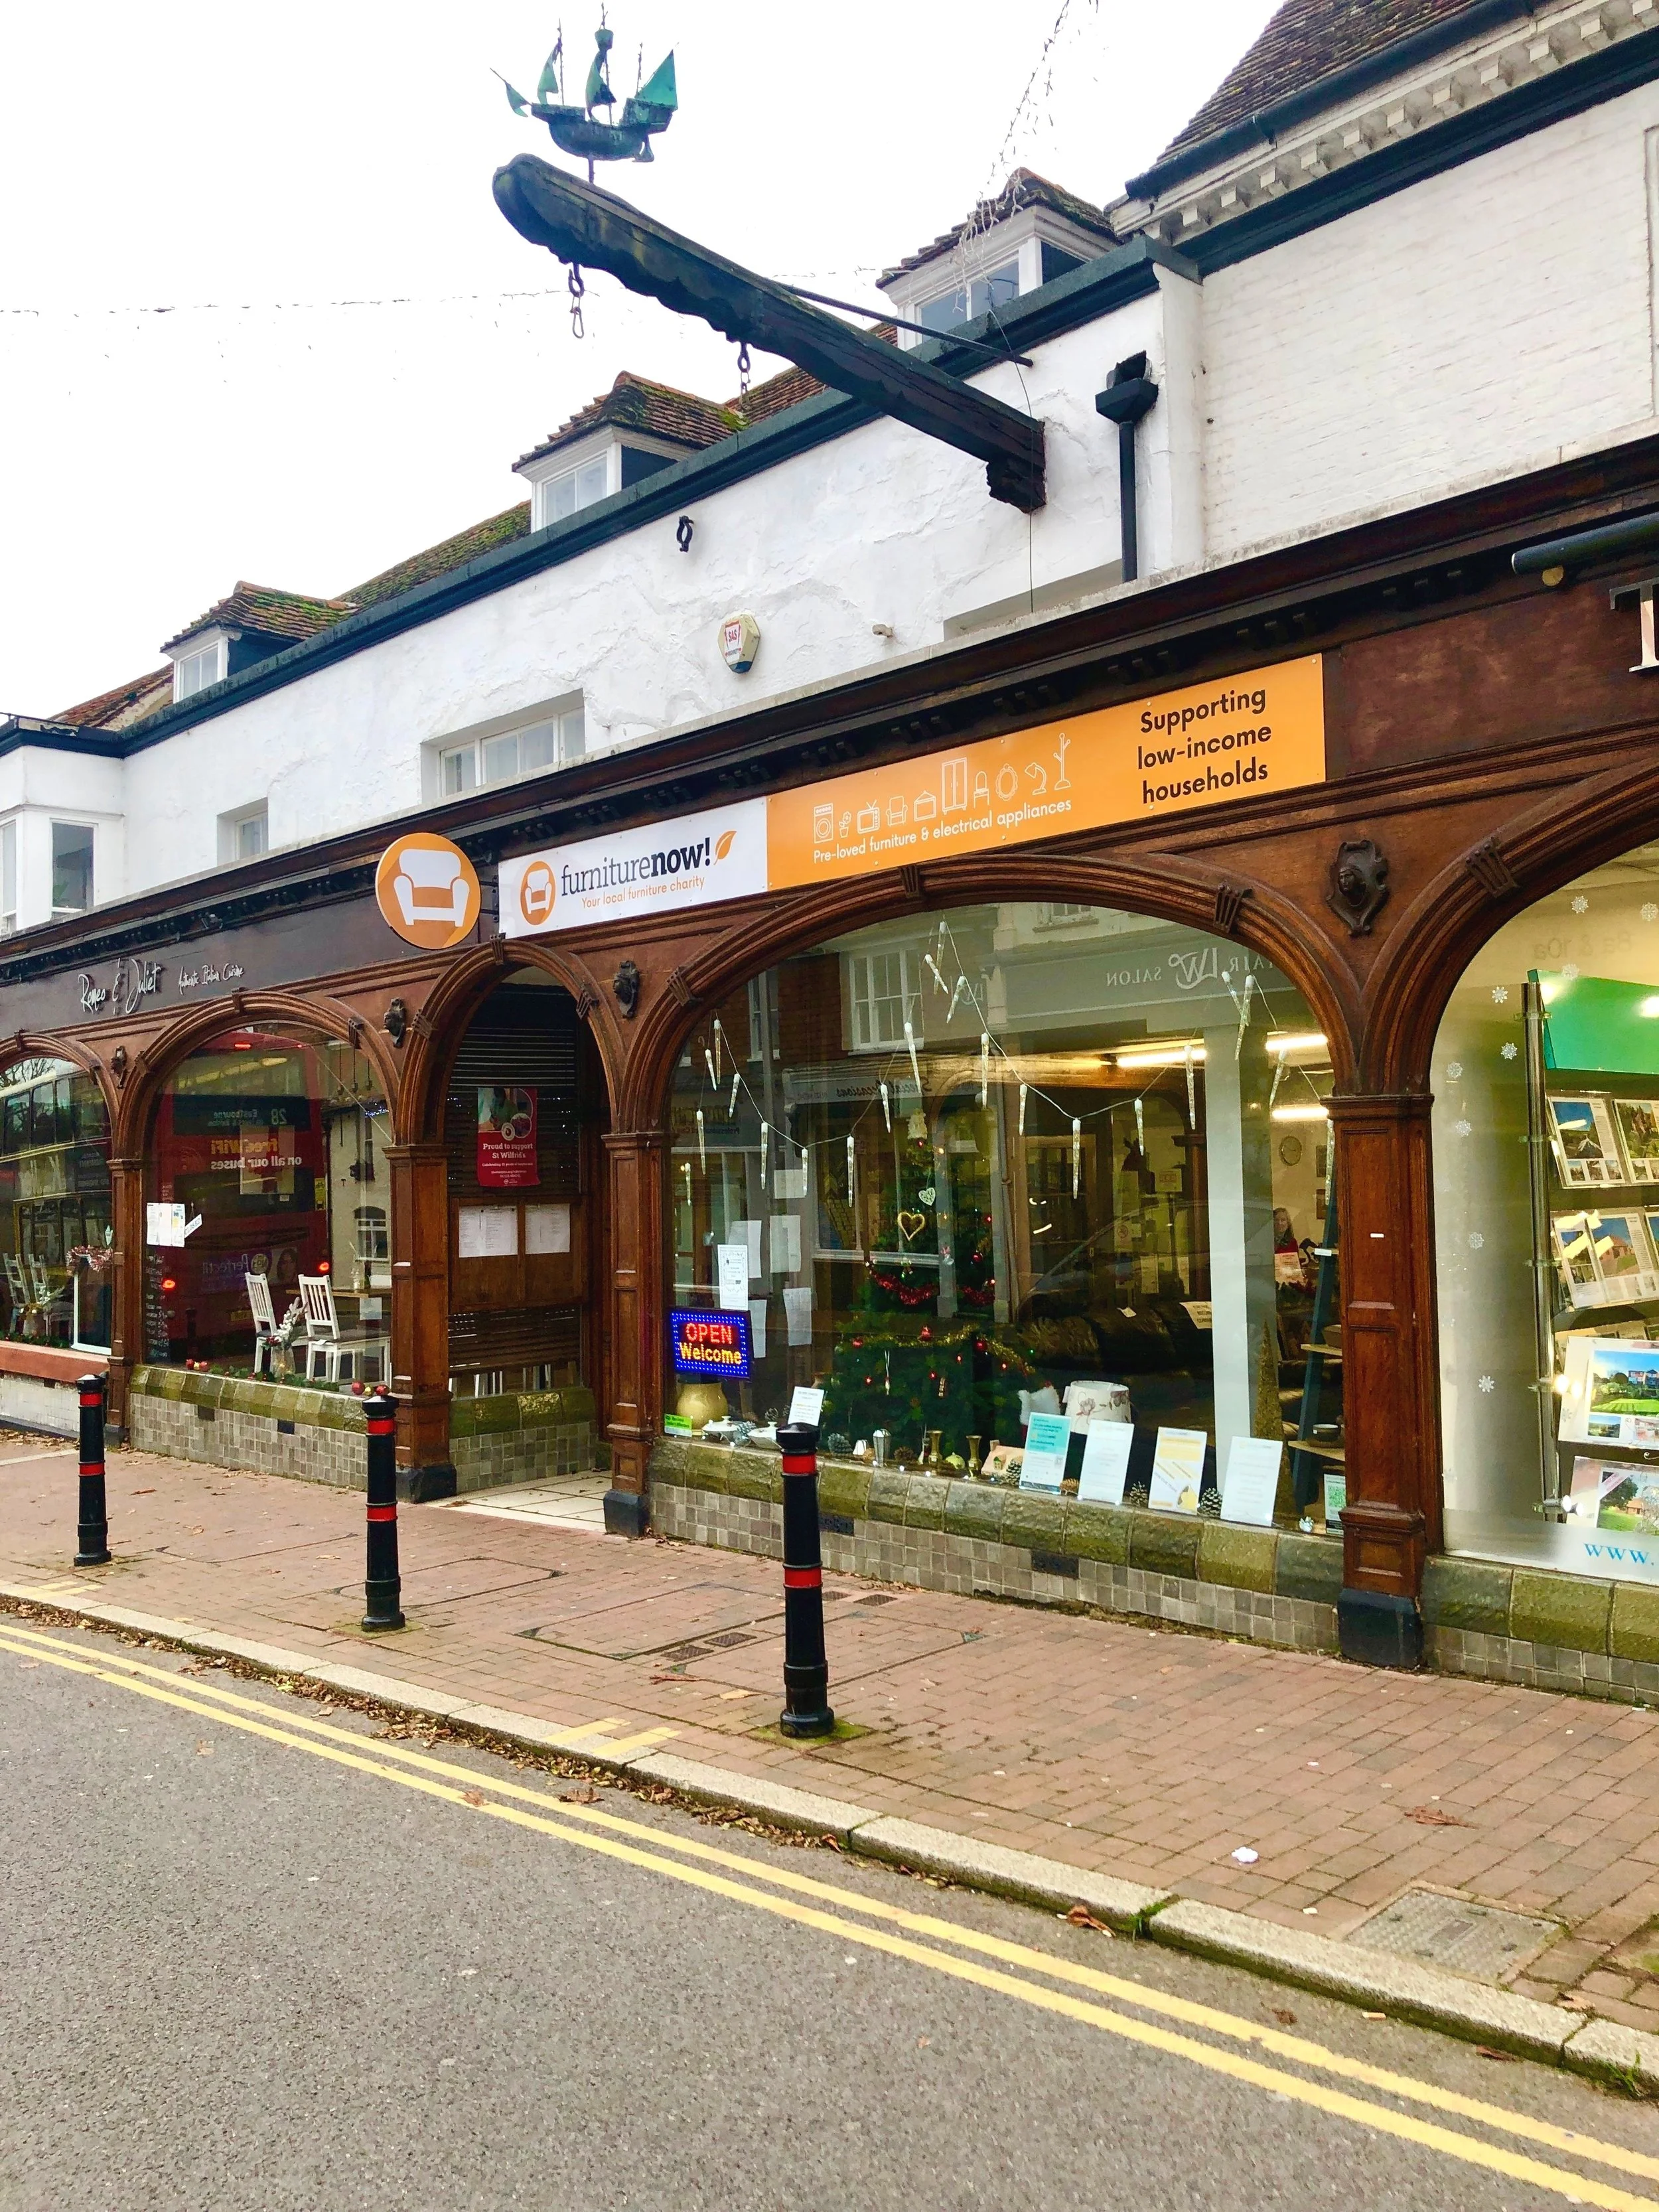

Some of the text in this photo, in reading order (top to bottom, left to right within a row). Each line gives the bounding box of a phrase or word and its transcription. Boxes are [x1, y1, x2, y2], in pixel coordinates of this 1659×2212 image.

[728, 629, 737, 642] SAS
[1140, 686, 1267, 734] Supporting
[1137, 723, 1272, 770] low-income
[1142, 759, 1269, 804] households
[813, 798, 1072, 864] Pre-loved furniture & electrical appliances
[561, 837, 711, 897] furniturenow!
[581, 875, 705, 909] Your local furniture charity
[78, 974, 106, 1014] Romeo
[125, 958, 161, 1014] Juliet
[184, 1218, 201, 1235] CLOSED
[680, 1341, 742, 1364] Welcome
[685, 1322, 733, 1345] OPEN
